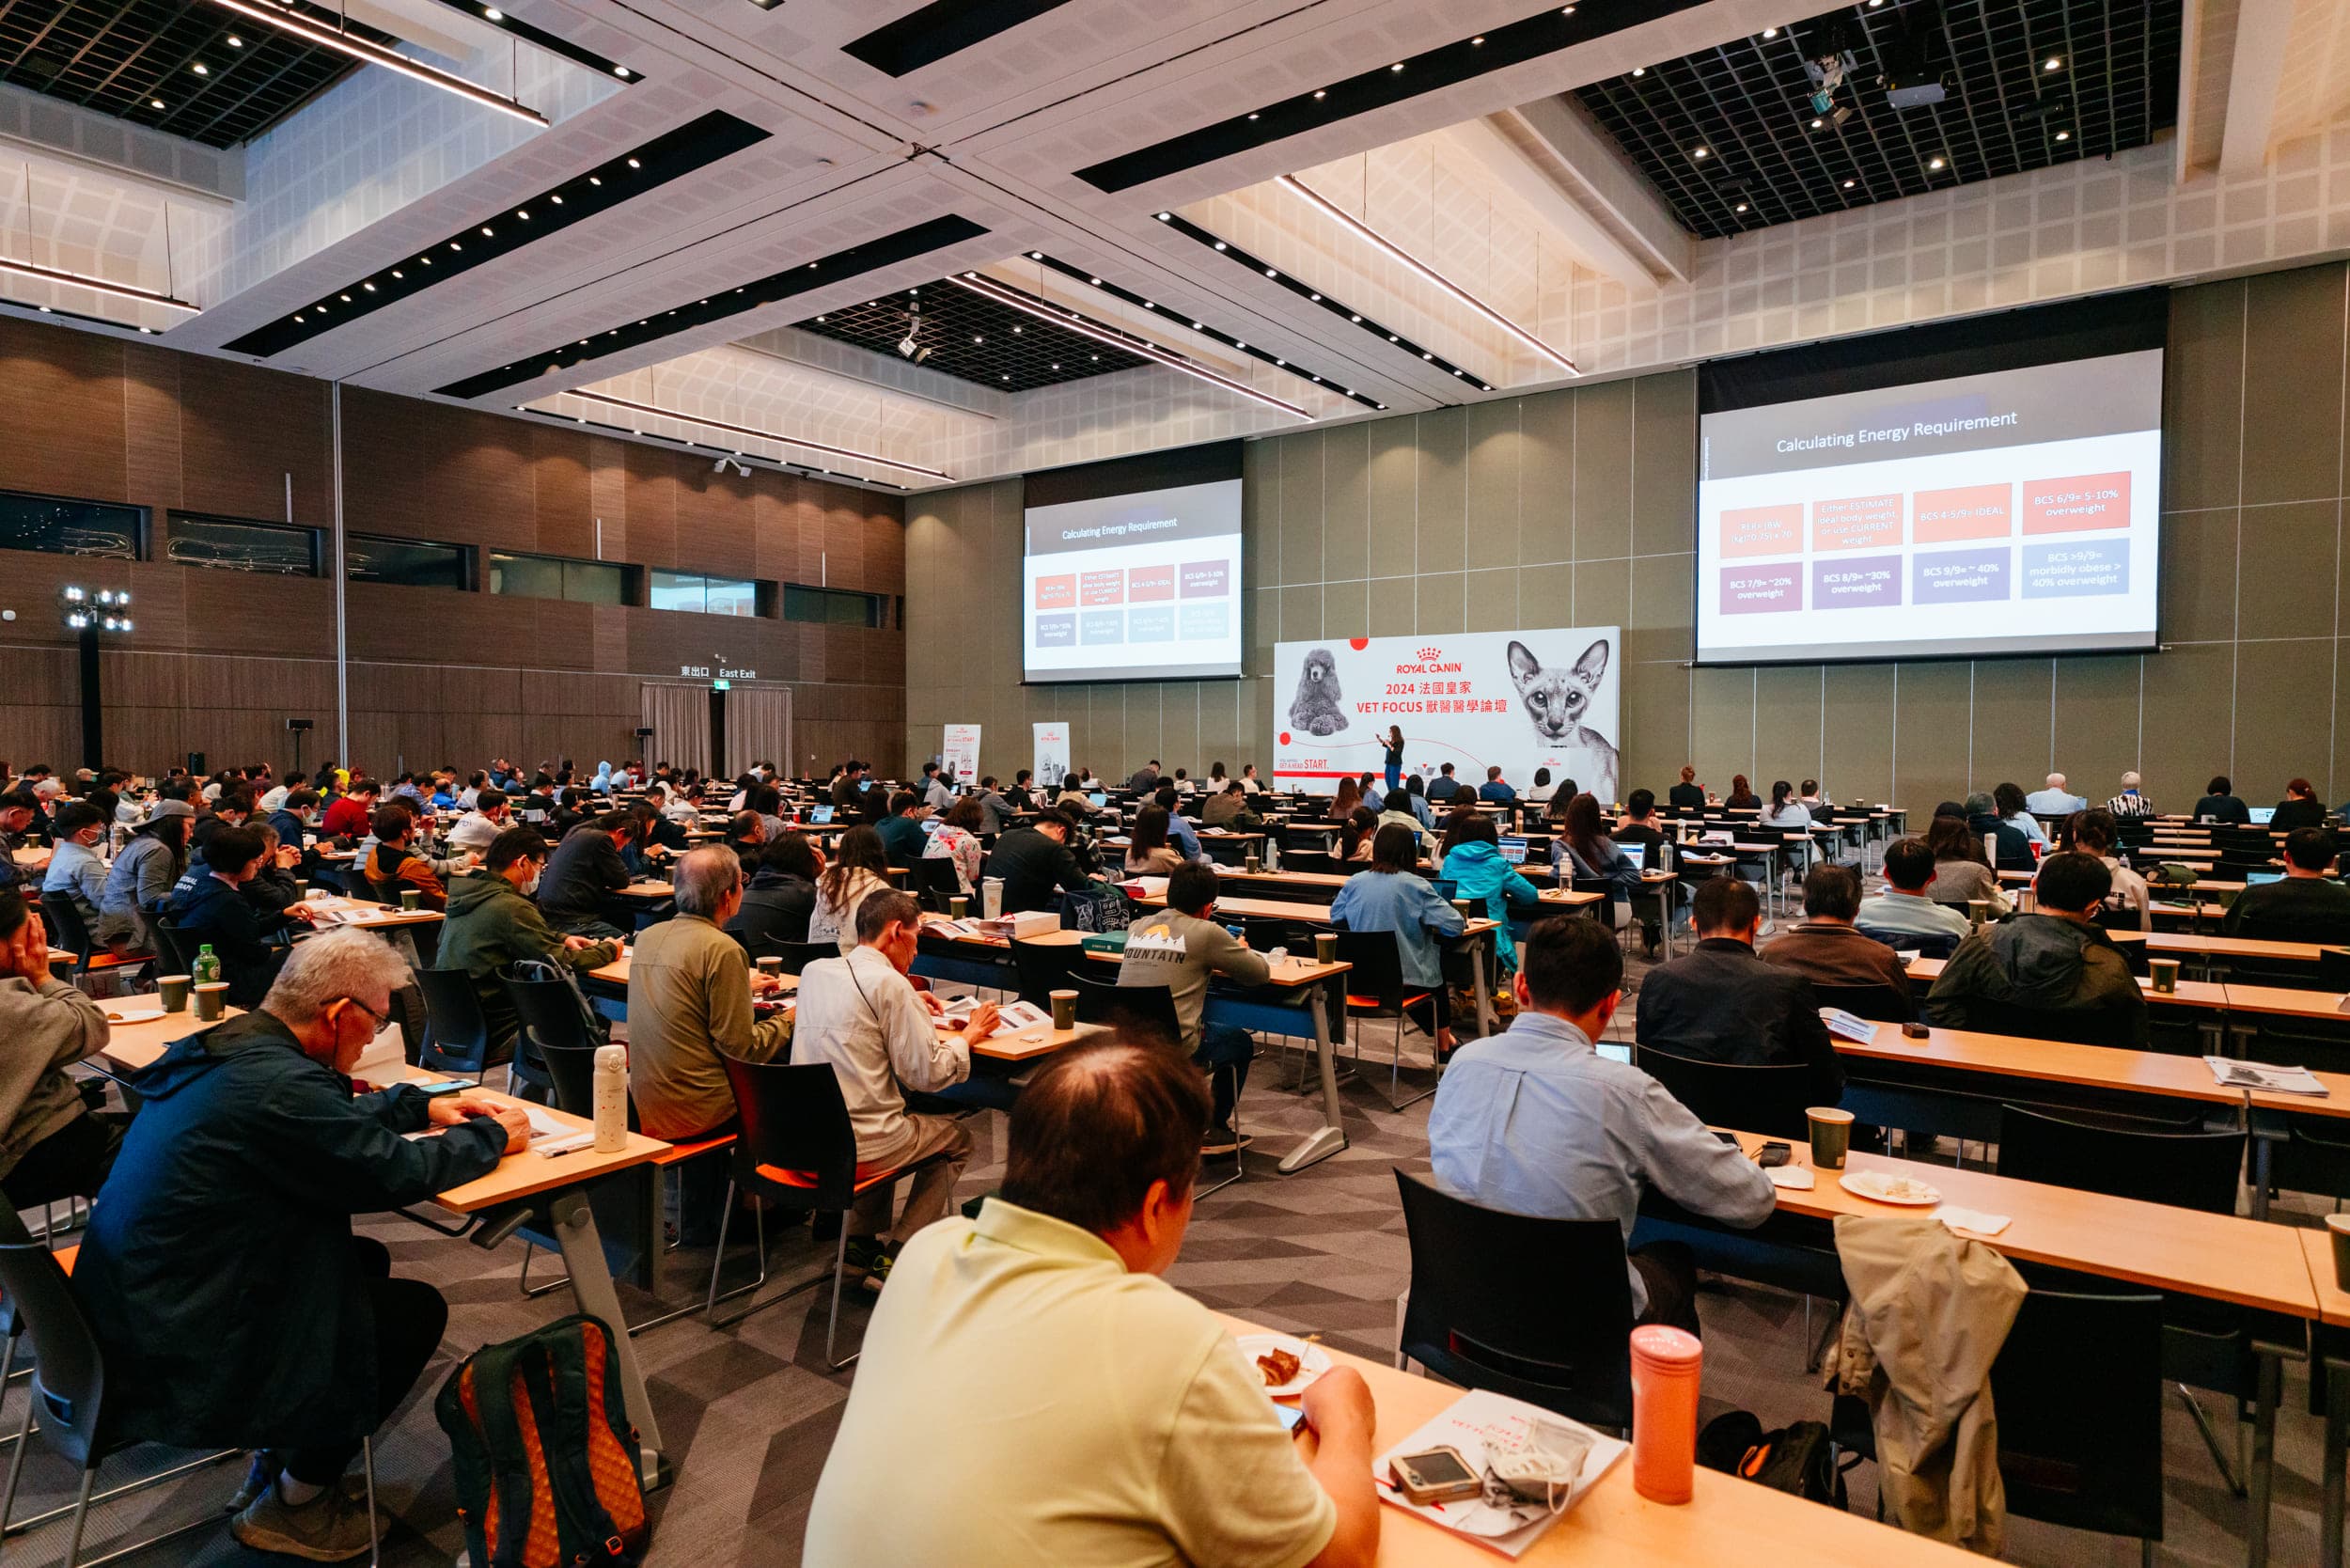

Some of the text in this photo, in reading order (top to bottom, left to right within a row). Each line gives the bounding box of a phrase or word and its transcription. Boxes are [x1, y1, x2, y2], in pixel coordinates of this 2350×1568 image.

[1777, 411, 2018, 452] Calculating Energy Requirement
[2034, 494, 2054, 505] BCS
[2057, 493, 2081, 504] 6/9=
[1820, 498, 1895, 513] Either ESTIMATE
[2045, 503, 2106, 517] overweight
[1841, 512, 1863, 524] body
[1920, 511, 1938, 522] BCS
[1975, 505, 2005, 517] IDEAL
[1062, 517, 1178, 540] Calculating Energy Requirement
[1850, 521, 1894, 533] CURRENT
[1841, 535, 1872, 546] weight
[2047, 552, 2068, 562] BCS
[1923, 567, 1942, 576] BCS
[1944, 566, 1966, 576] 9/9=
[1978, 563, 1999, 573] 40%
[2030, 564, 2076, 576] morbidly
[2079, 563, 2111, 572] obese
[1730, 580, 1746, 589] BCS
[1748, 579, 1766, 588] 7/9=
[1824, 574, 1840, 584] BCS
[1842, 572, 1862, 583] 8/9=
[1933, 575, 1988, 588] overweight
[2058, 573, 2118, 587] overweight
[1737, 588, 1784, 601] overweight
[1831, 583, 1882, 594] overweight
[681, 666, 709, 677] 東出口
[719, 668, 756, 679] East Exit
[1396, 663, 1462, 674] ROYAL CANIN
[1386, 681, 1471, 695] 2024 法國皇家
[1356, 702, 1379, 713] VET
[1383, 701, 1423, 713] FOCUS
